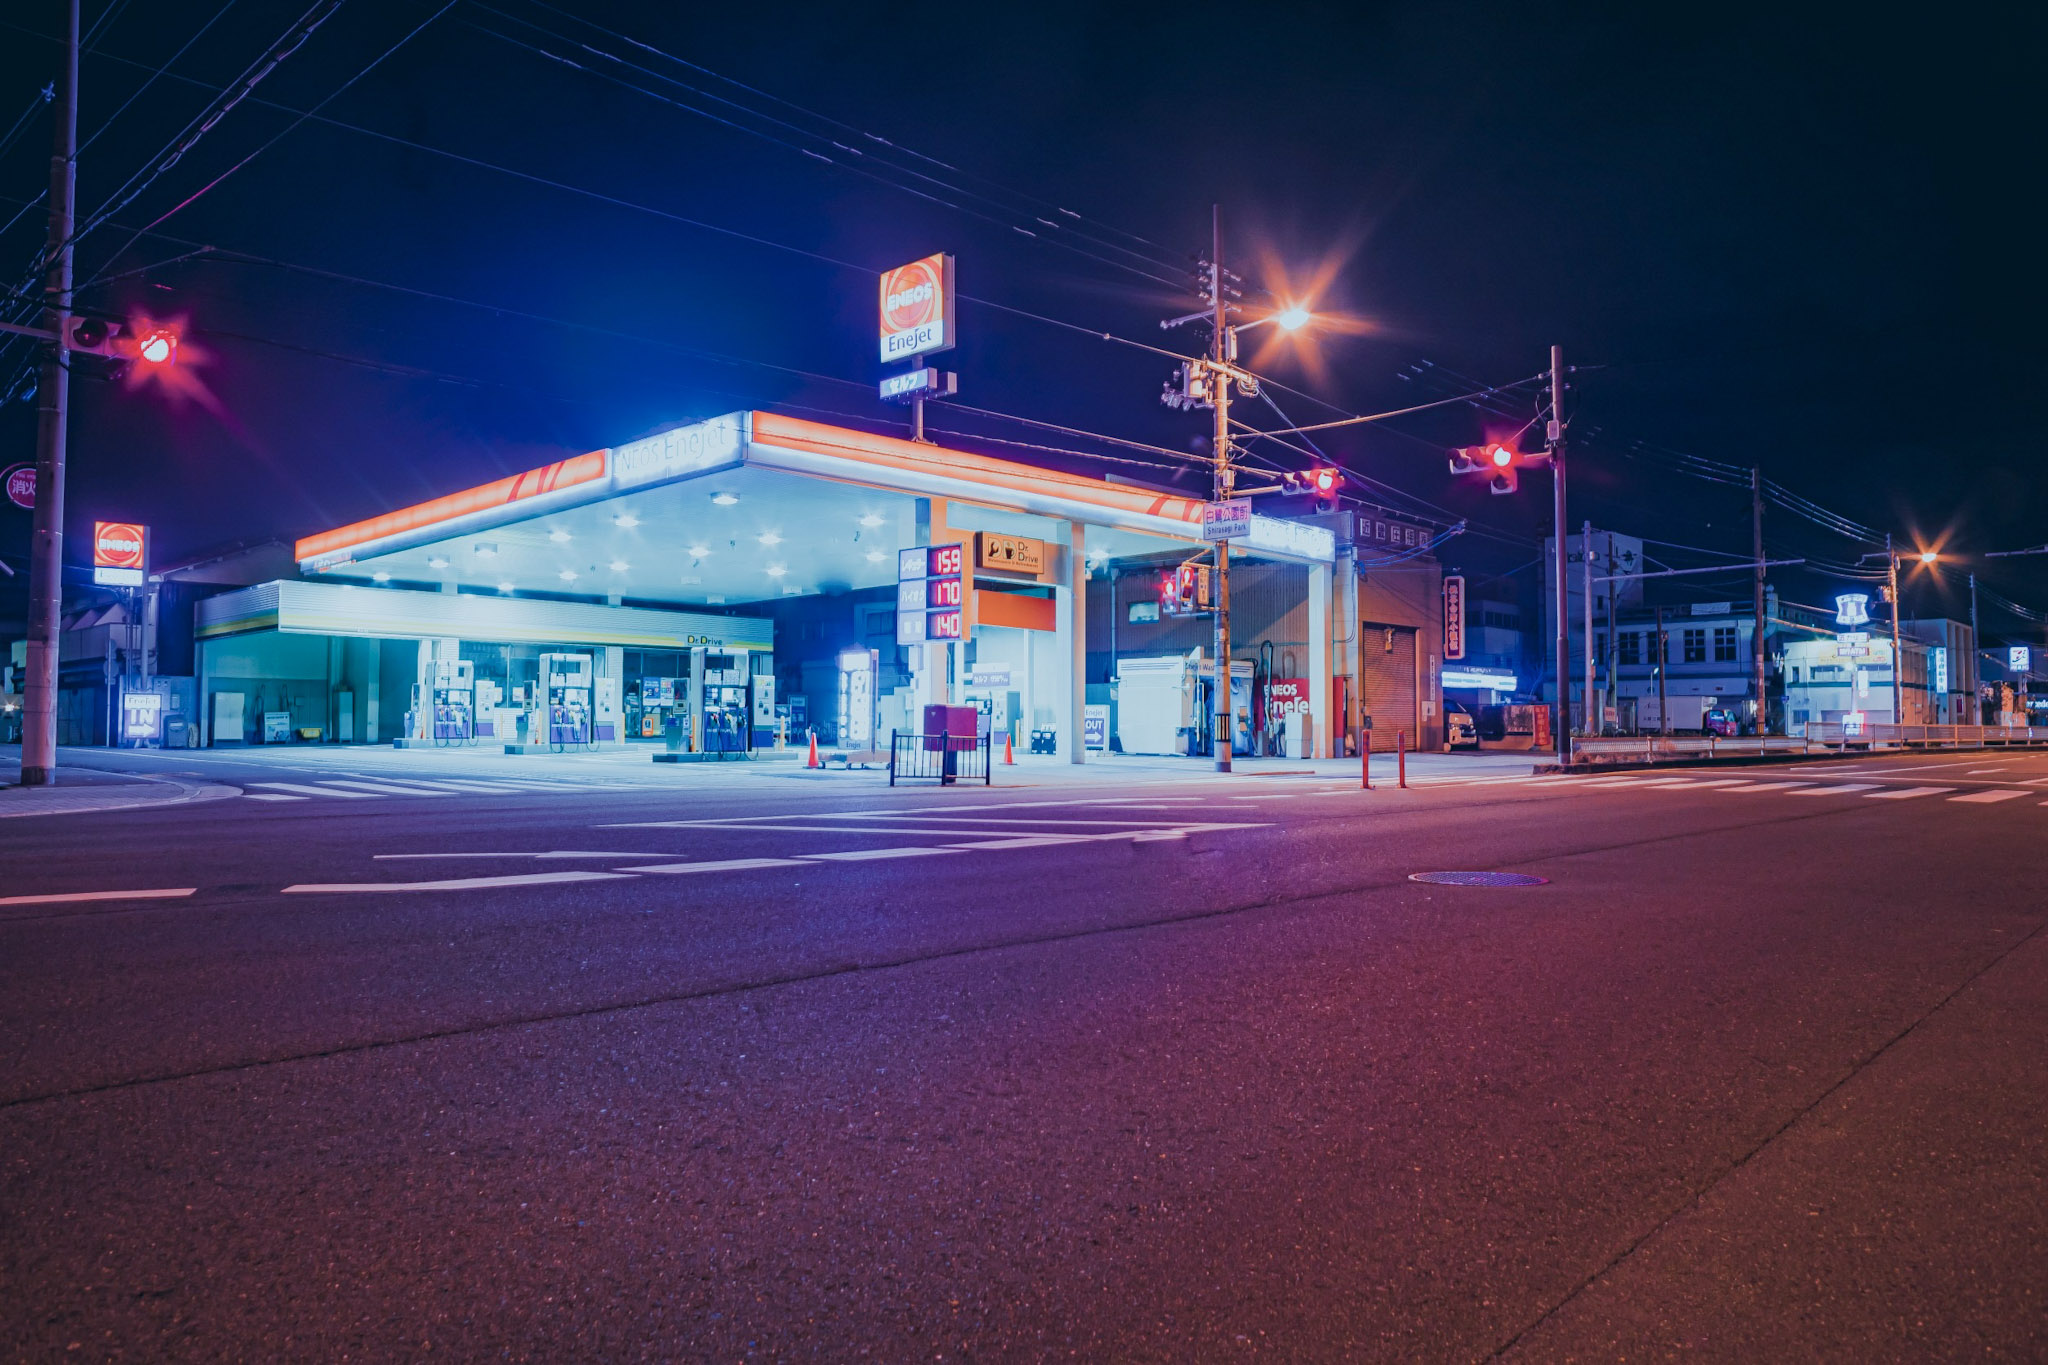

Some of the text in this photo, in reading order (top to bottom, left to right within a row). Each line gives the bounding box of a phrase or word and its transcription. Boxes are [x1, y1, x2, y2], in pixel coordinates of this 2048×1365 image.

[887, 282, 933, 312] ENEOS
[890, 373, 918, 394] セルフ
[12, 479, 36, 496] 消火
[1207, 523, 1246, 535] Shirasagi Park
[98, 538, 140, 553] ENEOS
[1018, 541, 1029, 552] Dr.
[937, 549, 960, 574] 159
[1018, 551, 1038, 564] Drive
[937, 581, 960, 605] 170
[937, 613, 960, 637] 140
[700, 635, 723, 646] Drive
[1202, 662, 1215, 671] Was
[1263, 683, 1298, 696] ENEOS
[130, 708, 155, 726] IN
[1084, 720, 1104, 730] OUT
